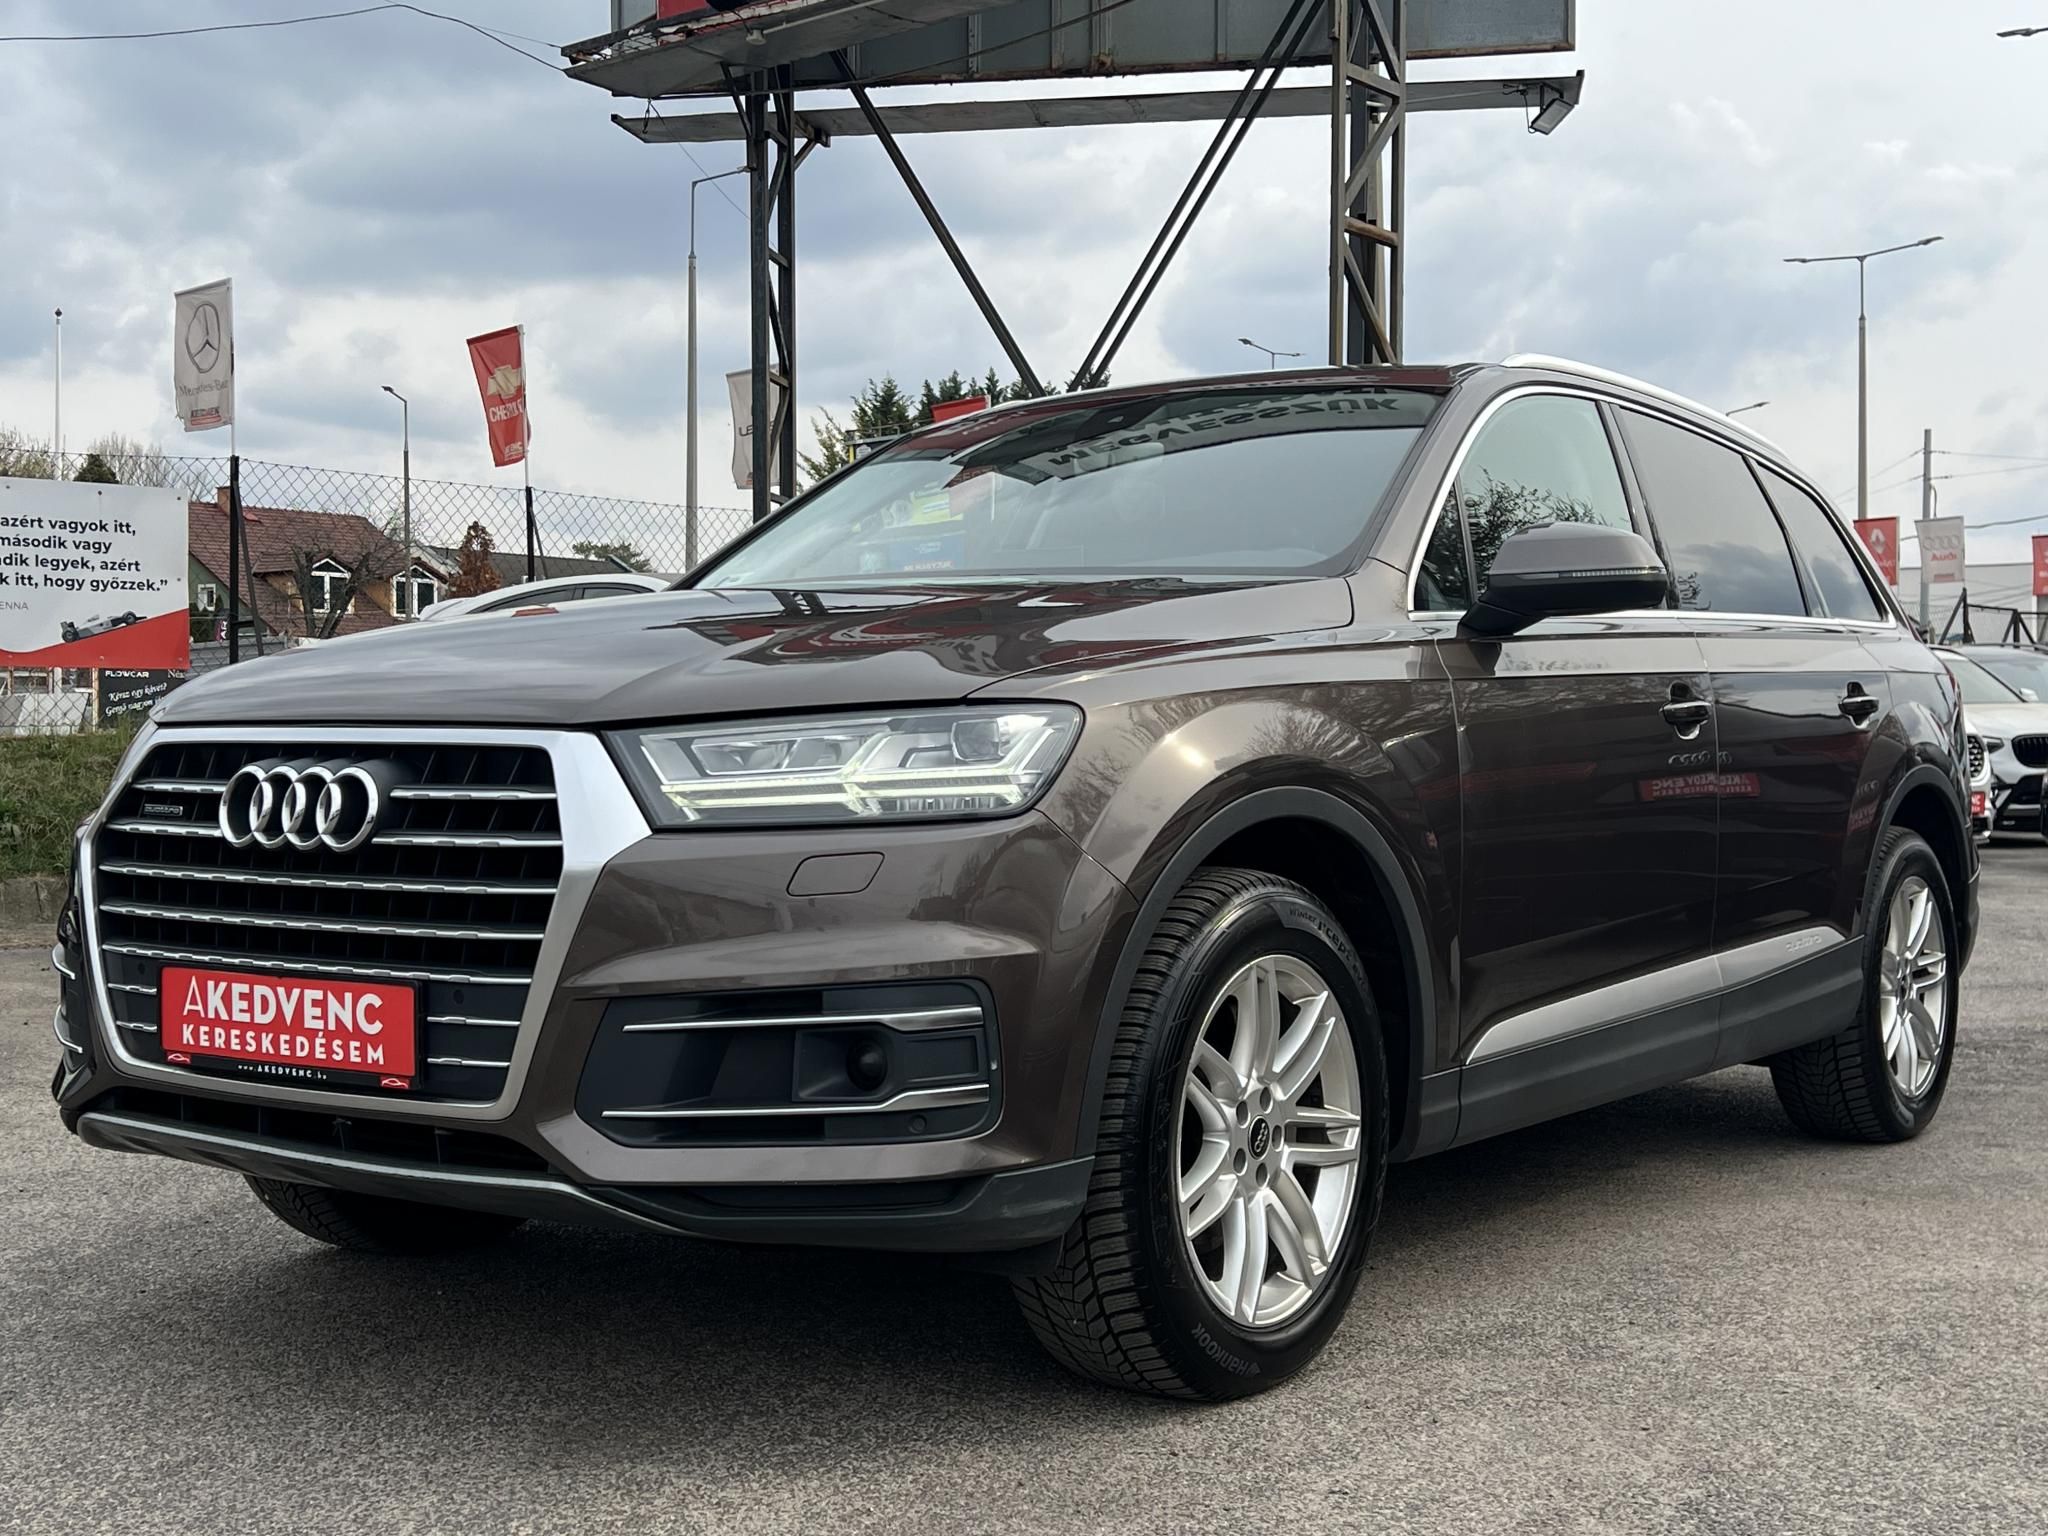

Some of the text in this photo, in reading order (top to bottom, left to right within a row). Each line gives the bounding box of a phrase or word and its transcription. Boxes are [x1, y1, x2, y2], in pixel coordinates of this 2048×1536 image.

[1, 515, 136, 536] azért vagyok itt,
[0, 534, 112, 554] második vagy
[0, 553, 141, 572] dik legyek, azért
[15, 572, 39, 589] itt,
[44, 574, 85, 591] hogy
[105, 670, 149, 678] FLOWCAR
[183, 975, 383, 1036] AKEDVENC
[182, 1023, 385, 1065] KERESKEDÉSEM
